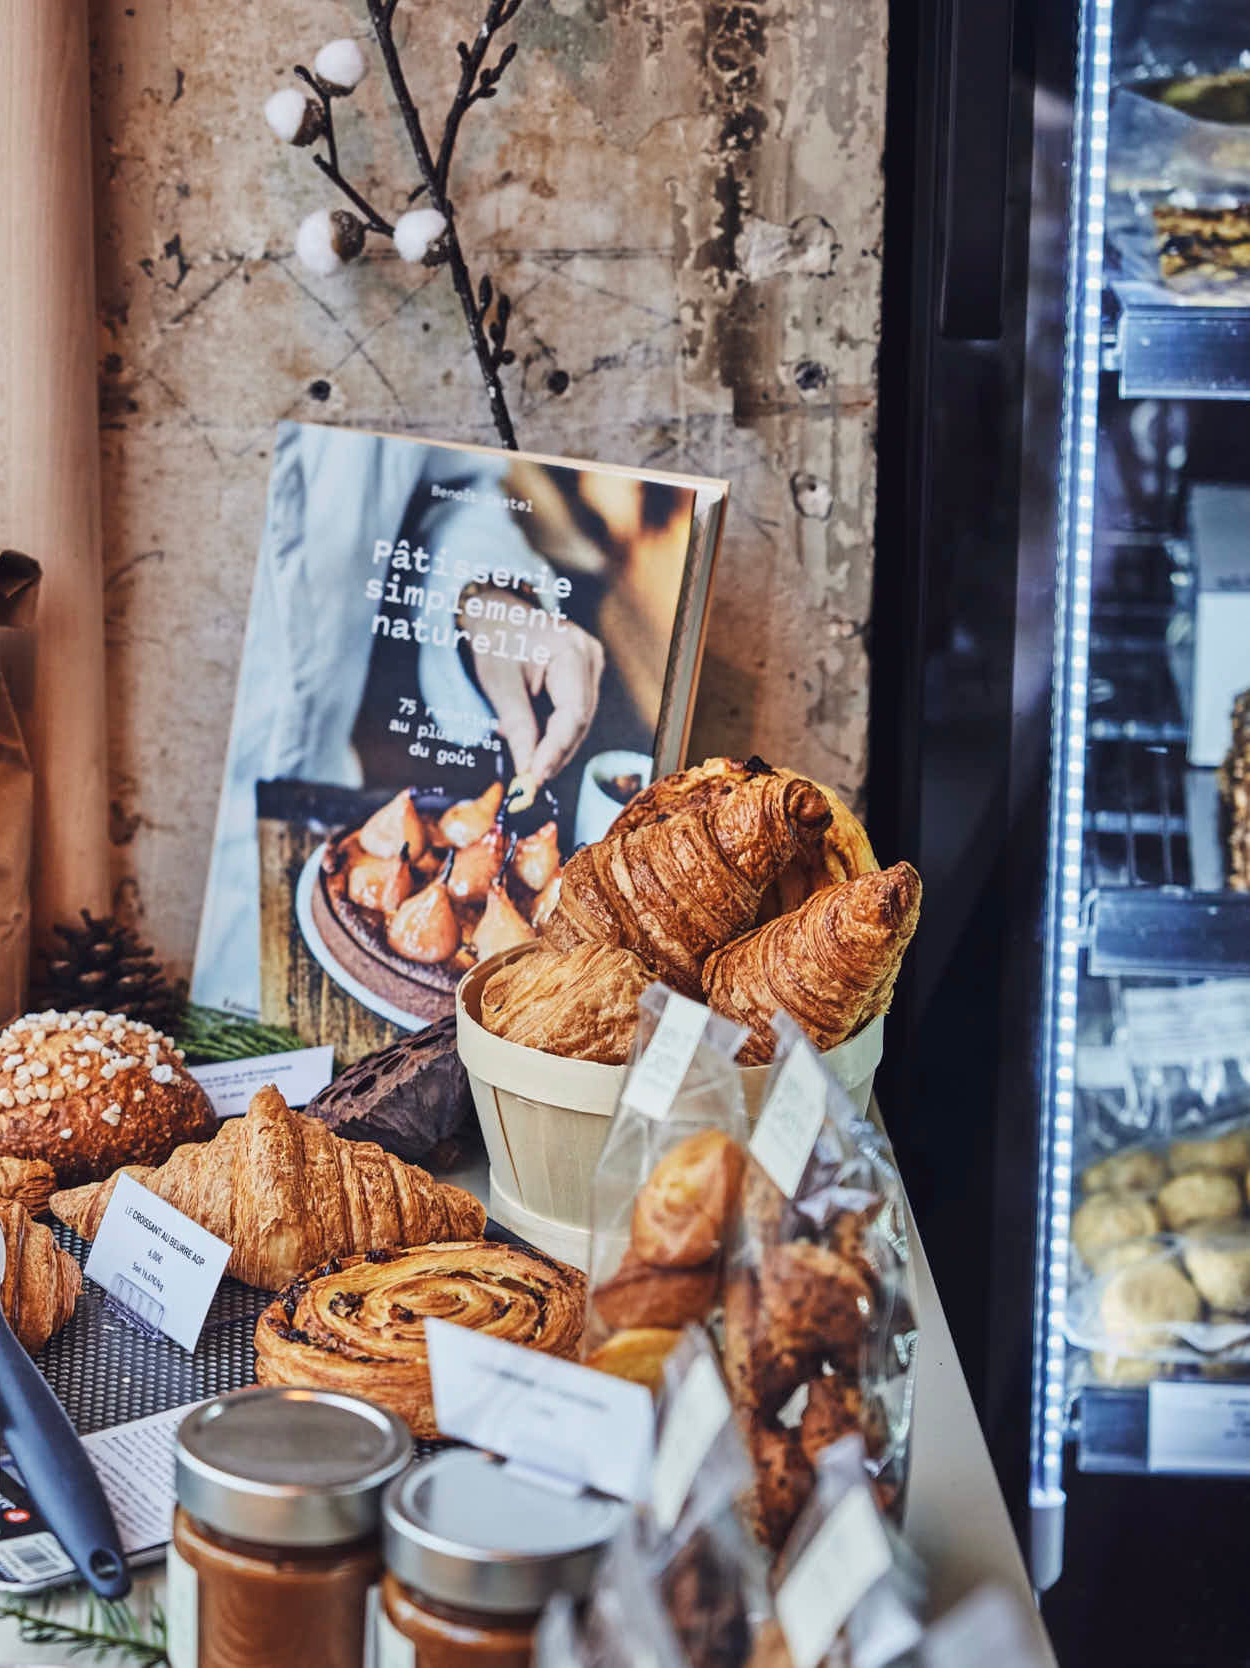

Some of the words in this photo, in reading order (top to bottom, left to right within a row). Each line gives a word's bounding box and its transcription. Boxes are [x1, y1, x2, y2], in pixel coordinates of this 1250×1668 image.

[485, 492, 533, 513] stel
[372, 539, 573, 598] Pâtisserie
[365, 573, 568, 633] simplement
[371, 614, 551, 664] naturelle
[398, 697, 417, 716] 75
[390, 719, 410, 733] au
[408, 742, 430, 758] du
[436, 749, 476, 768] goût
[132, 1210, 162, 1236] CROISSANT
[160, 1231, 170, 1243] AU
[168, 1237, 192, 1260] BEURRE
[191, 1252, 206, 1266] AOP
